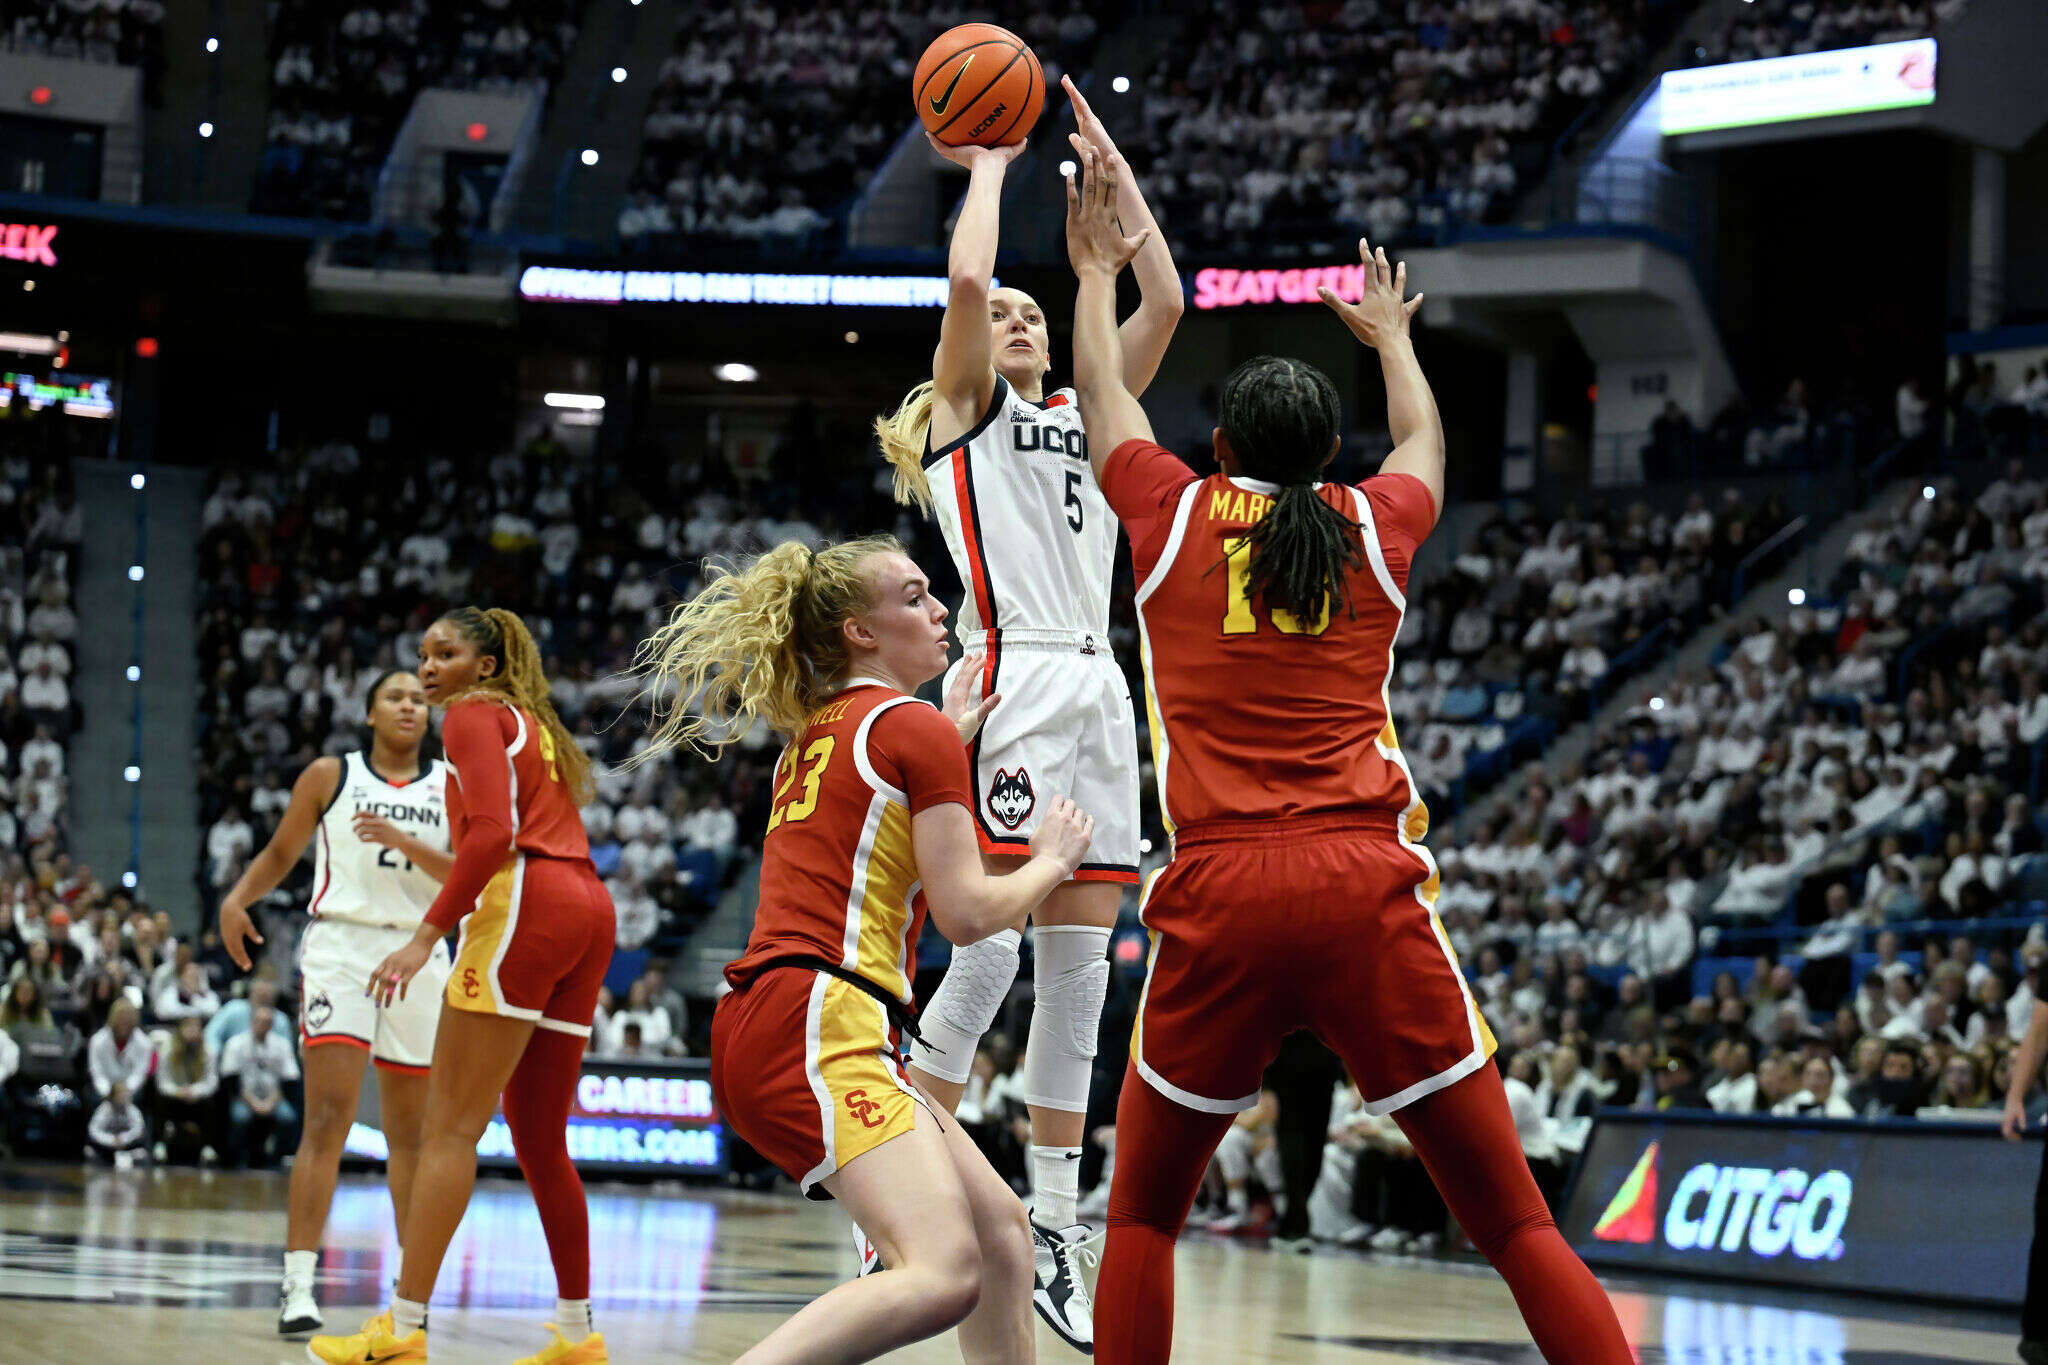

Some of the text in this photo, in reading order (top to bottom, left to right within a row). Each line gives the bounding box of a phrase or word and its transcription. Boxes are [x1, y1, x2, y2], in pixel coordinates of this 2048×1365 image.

[968, 102, 1007, 138] UCONN
[1064, 470, 1083, 534] 5
[765, 735, 836, 836] 23
[355, 801, 441, 827] UCONN
[463, 967, 480, 999] SC
[577, 1074, 714, 1118] CAREER
[844, 1089, 886, 1128] SC
[1664, 1162, 1853, 1260] CITGO
